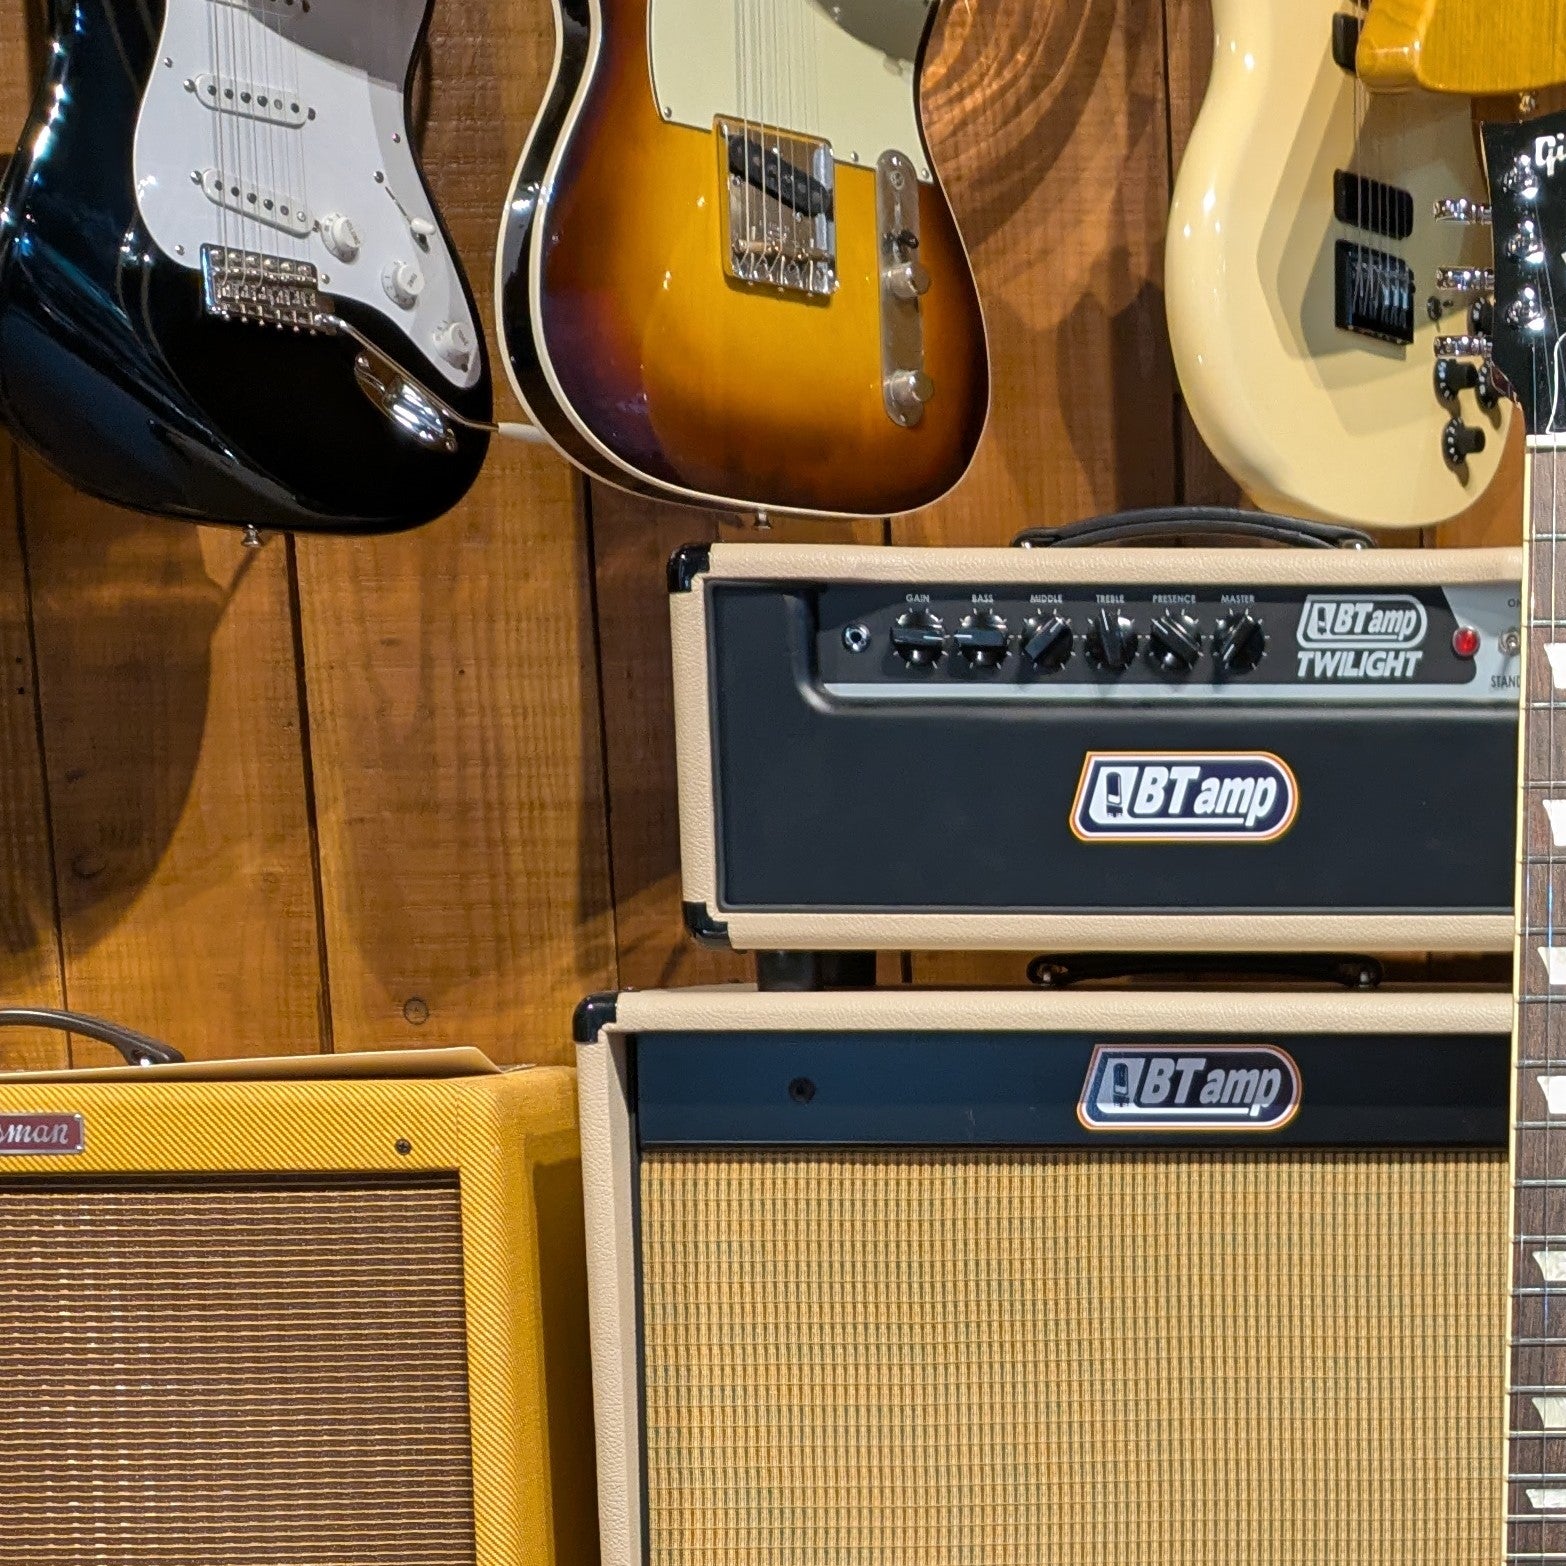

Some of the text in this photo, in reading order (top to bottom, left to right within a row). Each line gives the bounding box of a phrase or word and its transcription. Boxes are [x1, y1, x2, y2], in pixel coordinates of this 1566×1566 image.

[905, 594, 930, 603] GAIN
[971, 594, 994, 603] BASS
[1030, 594, 1063, 603] MIDDLE
[1096, 594, 1125, 604] TREBLE
[1152, 594, 1196, 604] PRESENCE
[1221, 594, 1255, 604] MASTER
[1297, 651, 1423, 677] TWILIGHT
